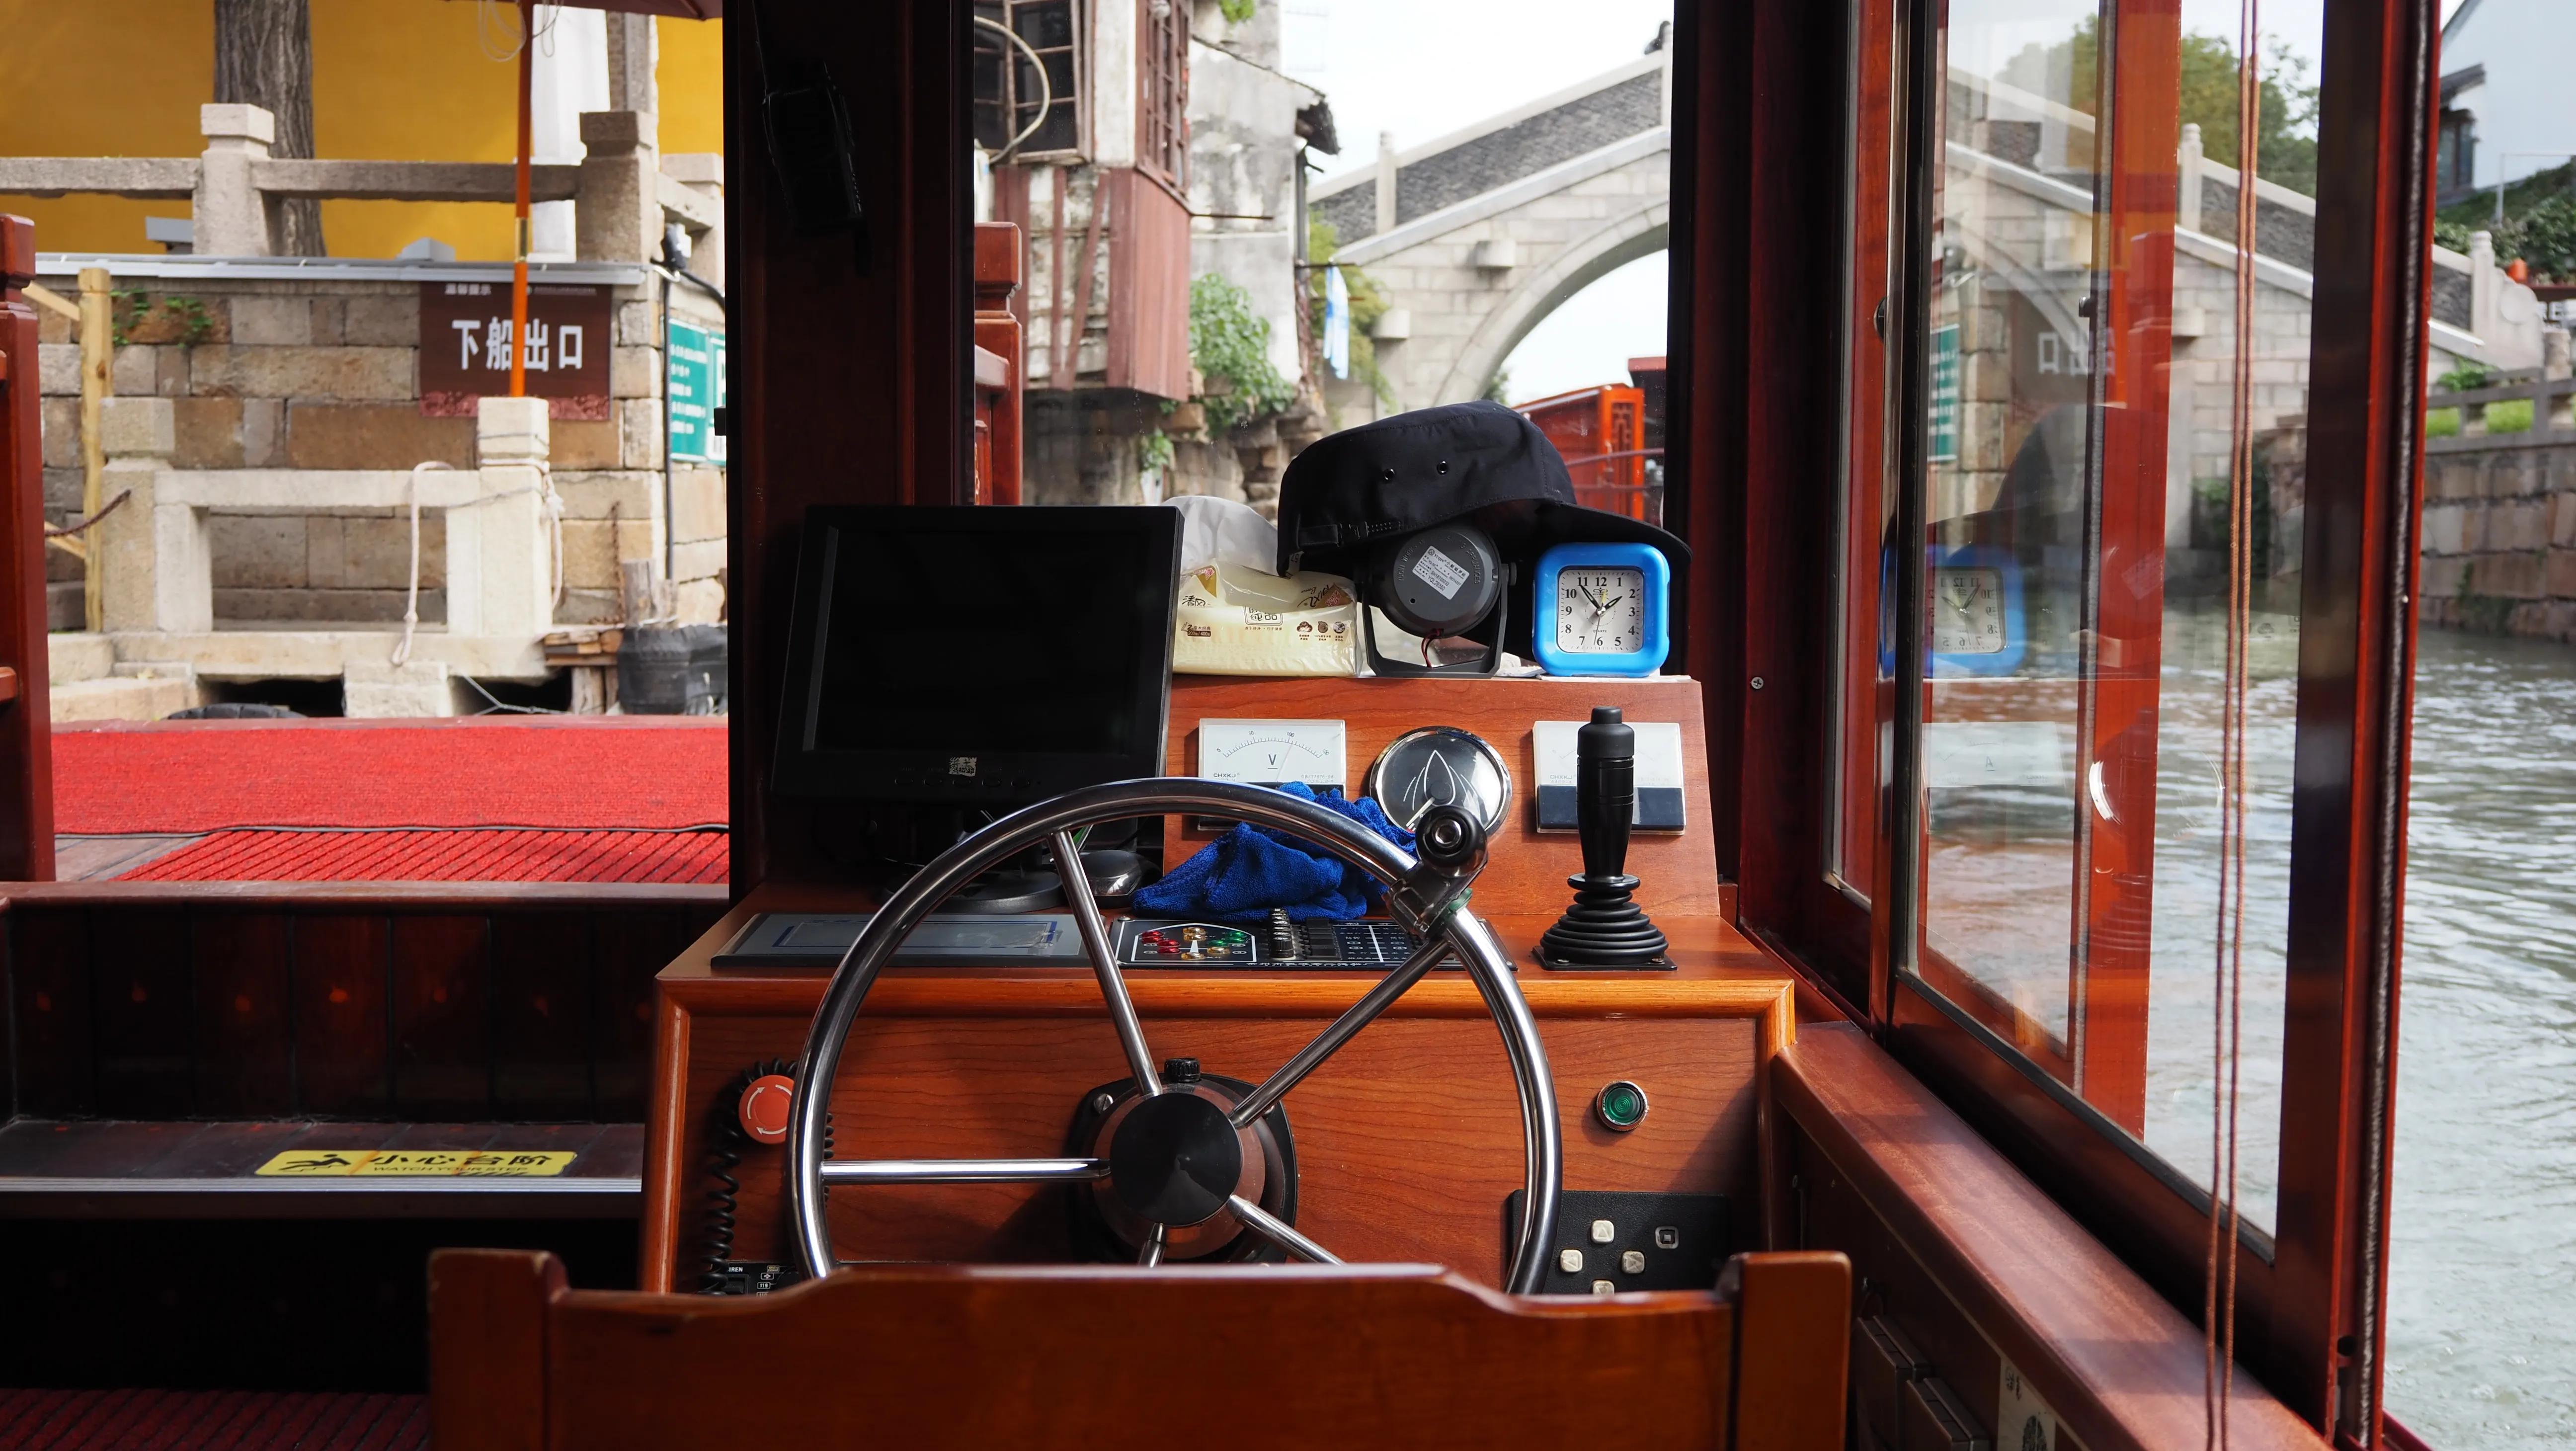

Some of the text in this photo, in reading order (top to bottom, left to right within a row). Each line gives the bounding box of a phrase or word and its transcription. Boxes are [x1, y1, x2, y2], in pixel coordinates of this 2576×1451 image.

[452, 316, 583, 372] 下船出口
[1577, 577, 1588, 586] 11
[1595, 577, 1607, 586] 12
[1617, 577, 1622, 587] 1
[1565, 588, 1577, 599] 10
[1629, 589, 1636, 598] 2
[1182, 595, 1206, 606] 清风
[1565, 606, 1572, 616] 9
[1628, 607, 1635, 617] 3
[1565, 624, 1572, 634] 8
[1628, 625, 1635, 635] 4
[1579, 636, 1585, 645] 7
[1597, 637, 1603, 646] 6
[1614, 637, 1621, 646] 5
[1268, 754, 1277, 766] V
[369, 1155, 552, 1165] 小心台阶
